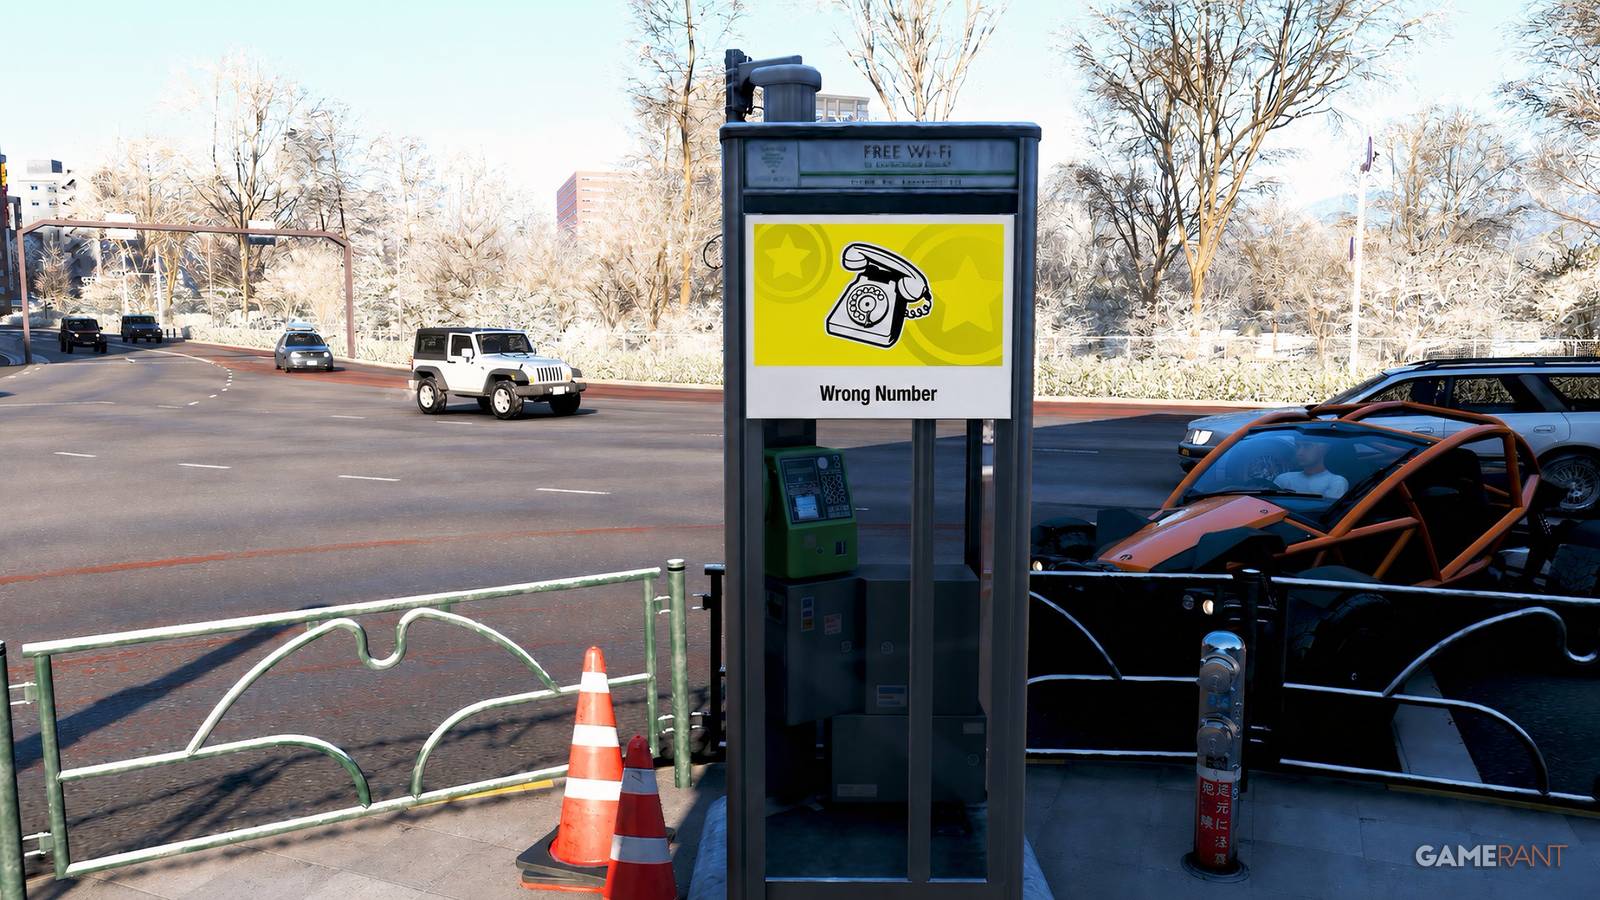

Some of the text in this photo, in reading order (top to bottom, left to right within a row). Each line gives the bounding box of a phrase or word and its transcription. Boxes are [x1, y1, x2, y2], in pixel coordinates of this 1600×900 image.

[863, 144, 901, 159] FREE
[819, 385, 938, 406] Wrong Number
